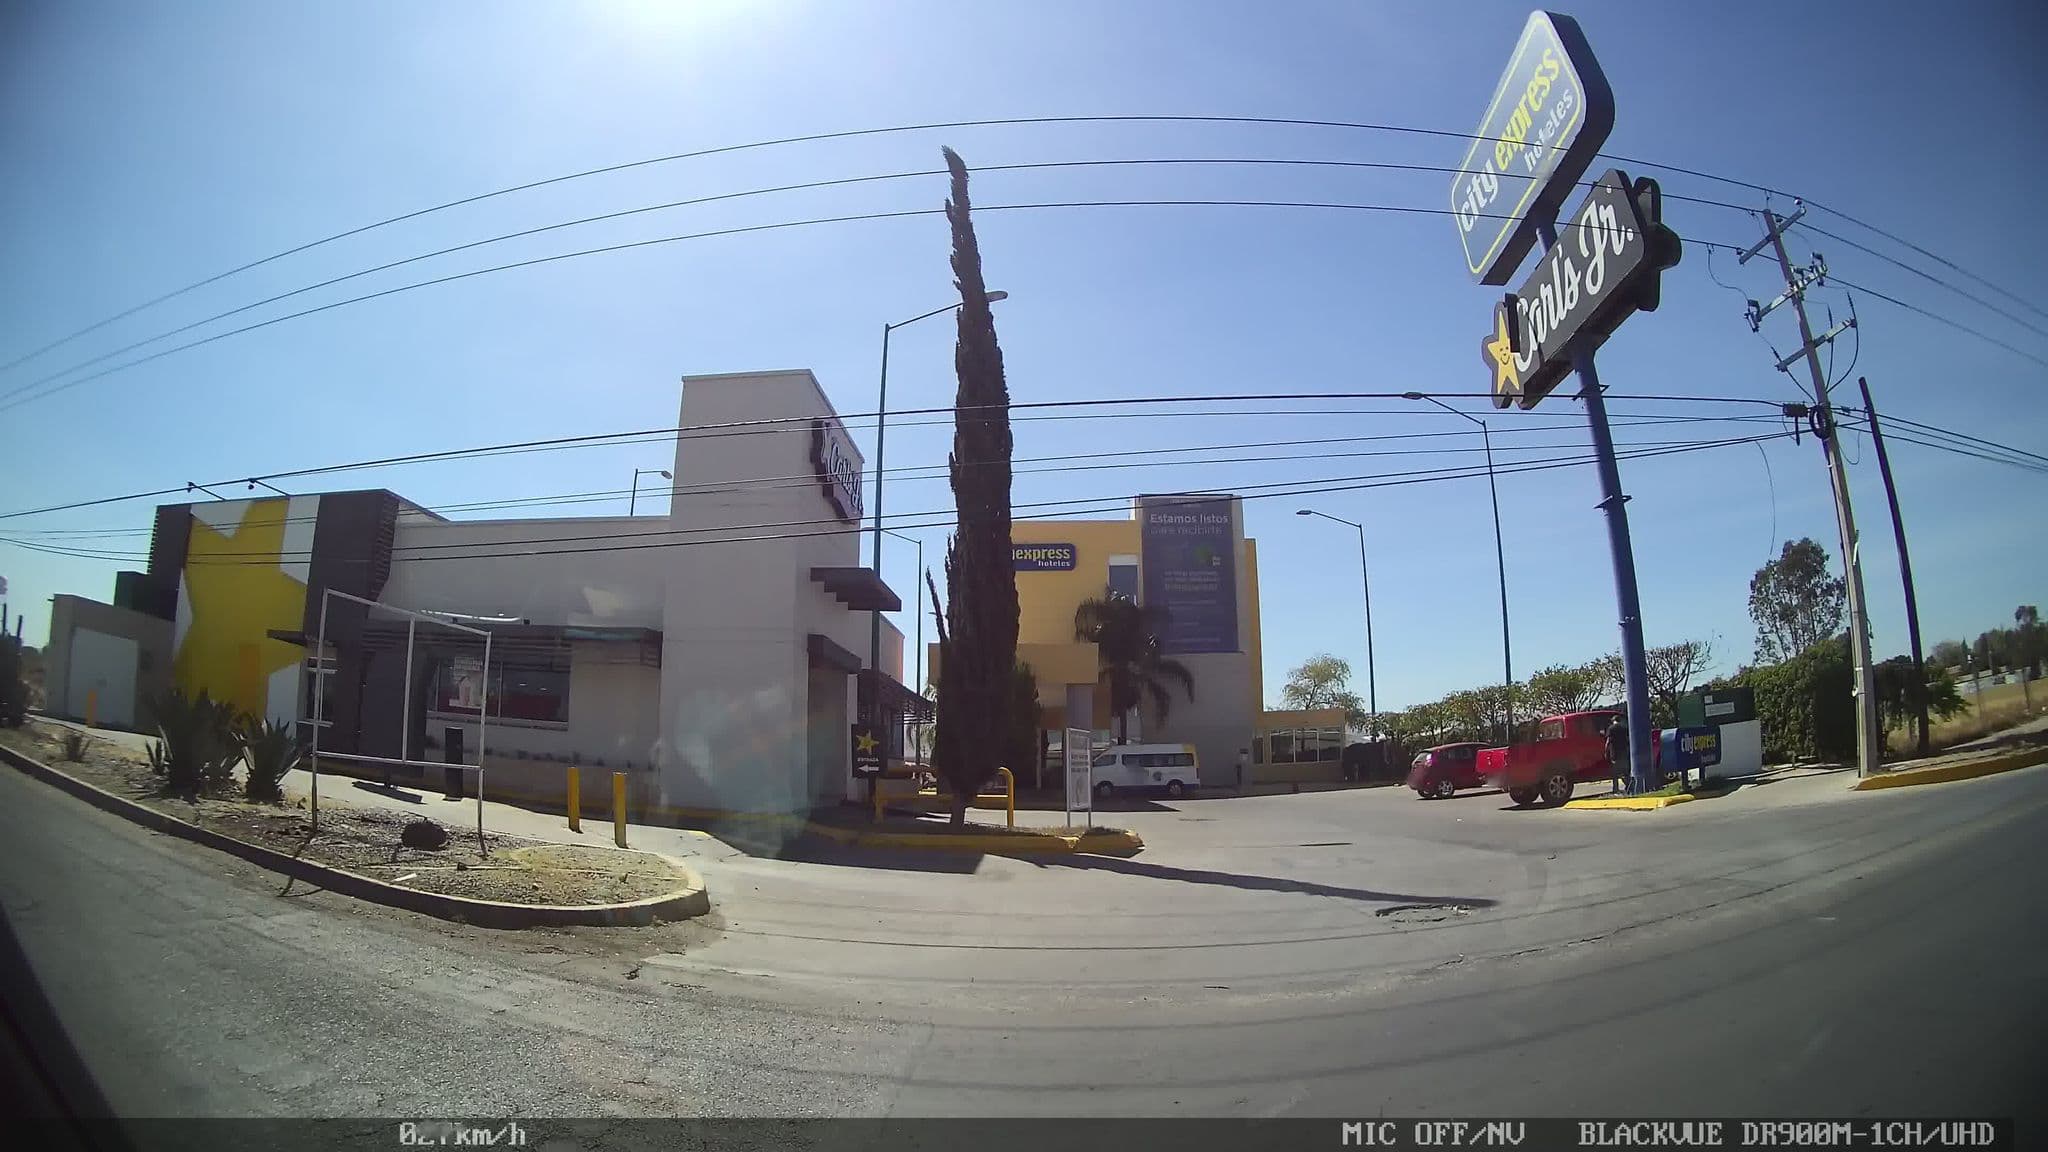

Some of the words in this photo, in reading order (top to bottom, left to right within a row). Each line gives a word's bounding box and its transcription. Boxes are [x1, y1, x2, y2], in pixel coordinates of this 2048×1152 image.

[1460, 159, 1499, 232] city
[1495, 48, 1560, 171] express
[1524, 89, 1574, 172] hoteles
[1513, 244, 1582, 373] Carl's
[1579, 200, 1634, 296] Jr.
[1150, 513, 1197, 524] Estamos
[1200, 513, 1229, 524] listos
[1015, 548, 1071, 561] express
[1681, 733, 1694, 754] city
